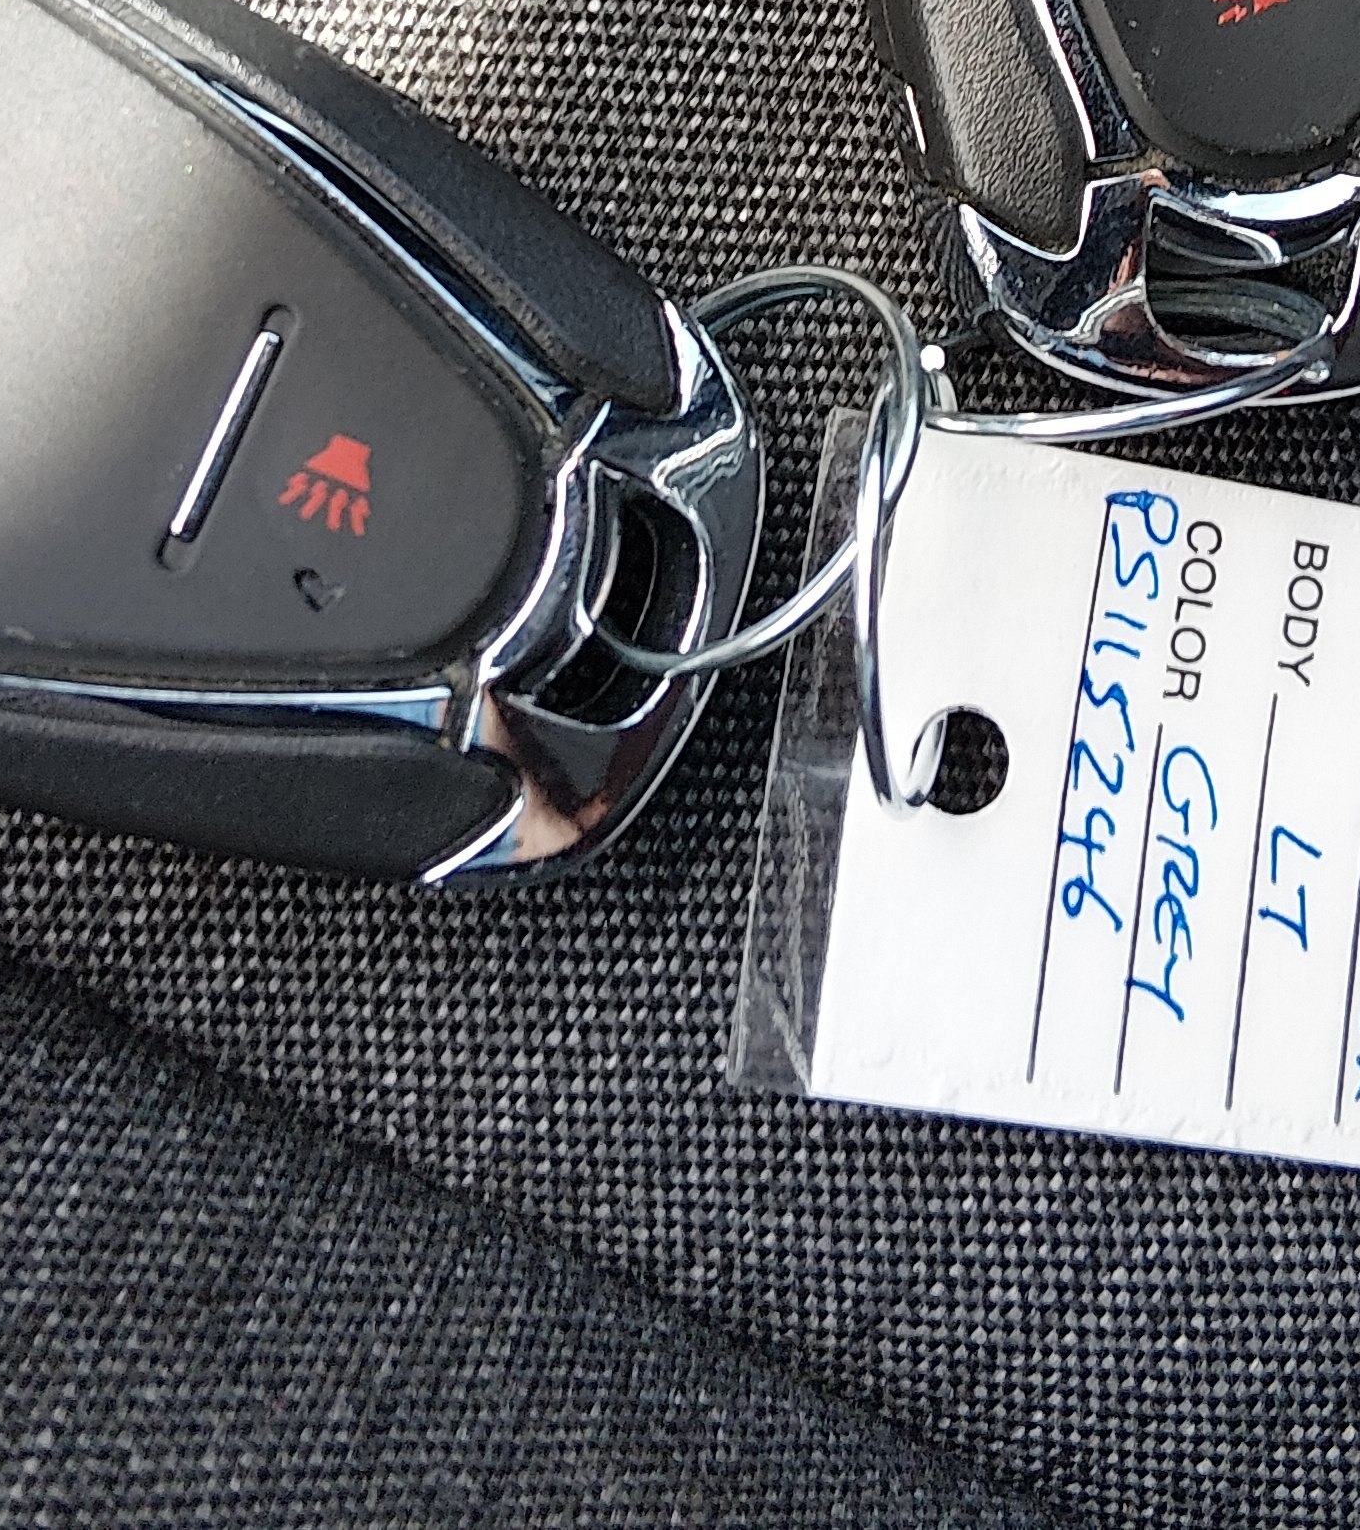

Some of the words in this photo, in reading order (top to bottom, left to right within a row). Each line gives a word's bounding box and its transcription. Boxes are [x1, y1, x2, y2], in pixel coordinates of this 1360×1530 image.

[1162, 519, 1223, 702] COLOR
[1277, 538, 1330, 688] BODY
[1124, 744, 1219, 1023] GREY
[1258, 824, 1323, 952] LT
